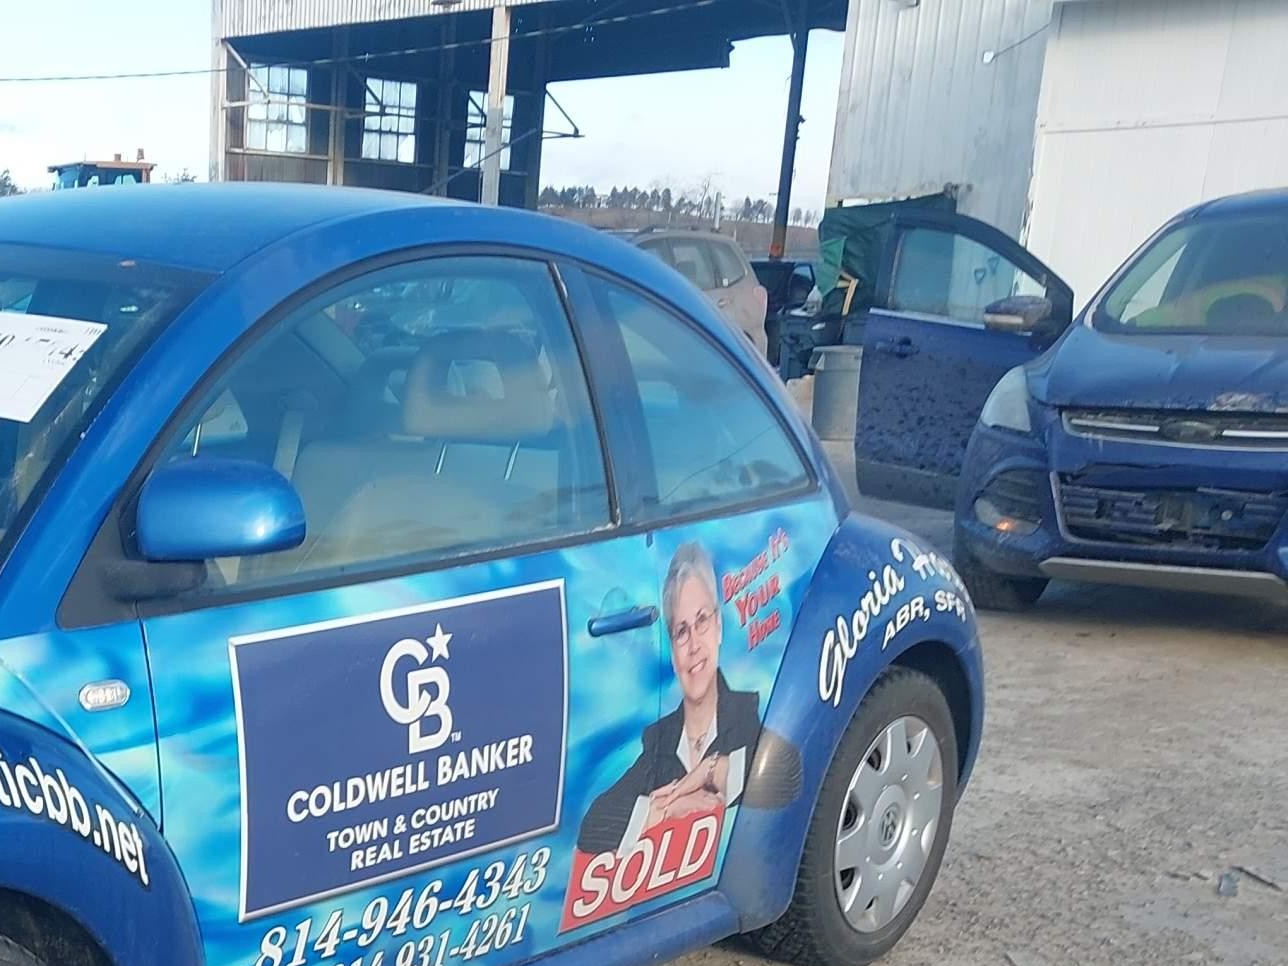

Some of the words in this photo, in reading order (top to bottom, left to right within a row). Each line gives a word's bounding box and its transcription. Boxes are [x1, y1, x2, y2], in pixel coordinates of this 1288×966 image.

[818, 564, 905, 707] Gloria
[882, 596, 931, 650] ABR,
[287, 762, 430, 823] COLDWELL
[437, 735, 534, 785] BANKER
[327, 818, 388, 852] TOWN
[393, 816, 407, 834] &
[411, 788, 500, 829] COUNTRY
[350, 841, 403, 871] REAL
[409, 818, 475, 855] ESTATE
[572, 815, 719, 920] SOLD
